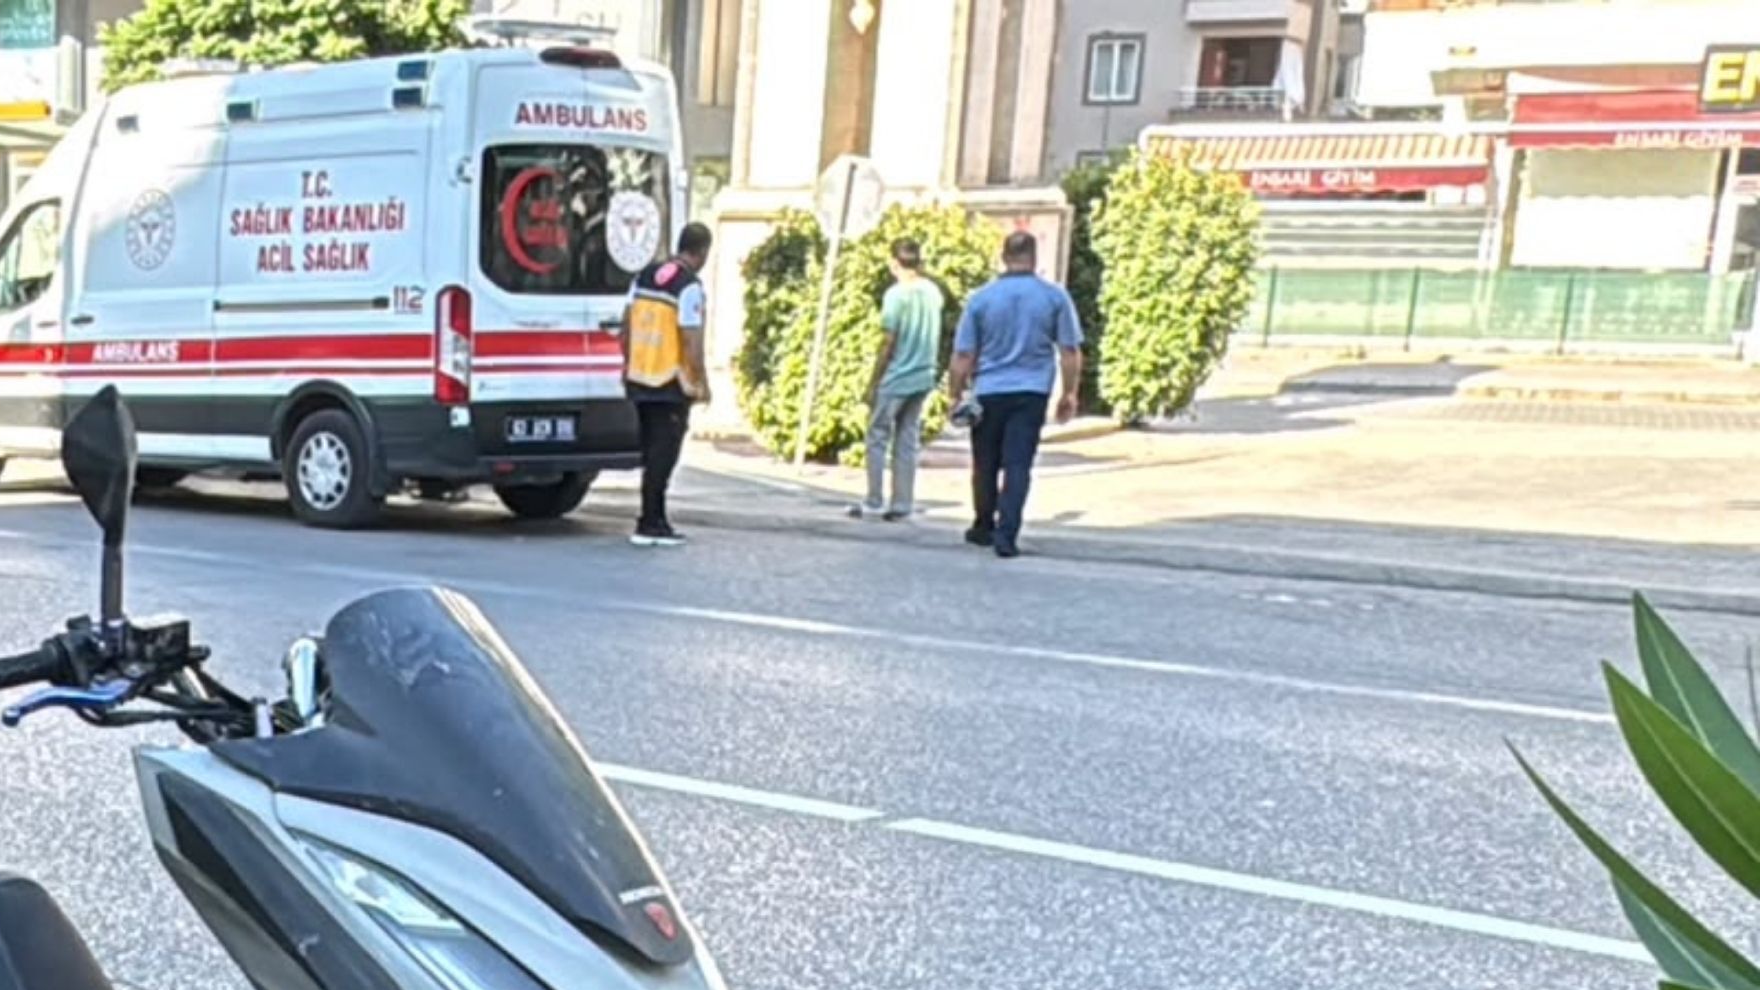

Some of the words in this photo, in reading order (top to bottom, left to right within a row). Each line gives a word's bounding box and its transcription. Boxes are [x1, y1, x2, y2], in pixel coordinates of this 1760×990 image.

[514, 102, 648, 132] AMBULANS
[301, 171, 333, 198] T.C.
[230, 203, 294, 236] SAĞLIK
[302, 196, 406, 234] BAKANLIĞI
[256, 240, 295, 273] ACİL
[302, 238, 370, 272] SAĞLIK
[393, 285, 427, 313] 112
[92, 341, 178, 362] AMBULANS
